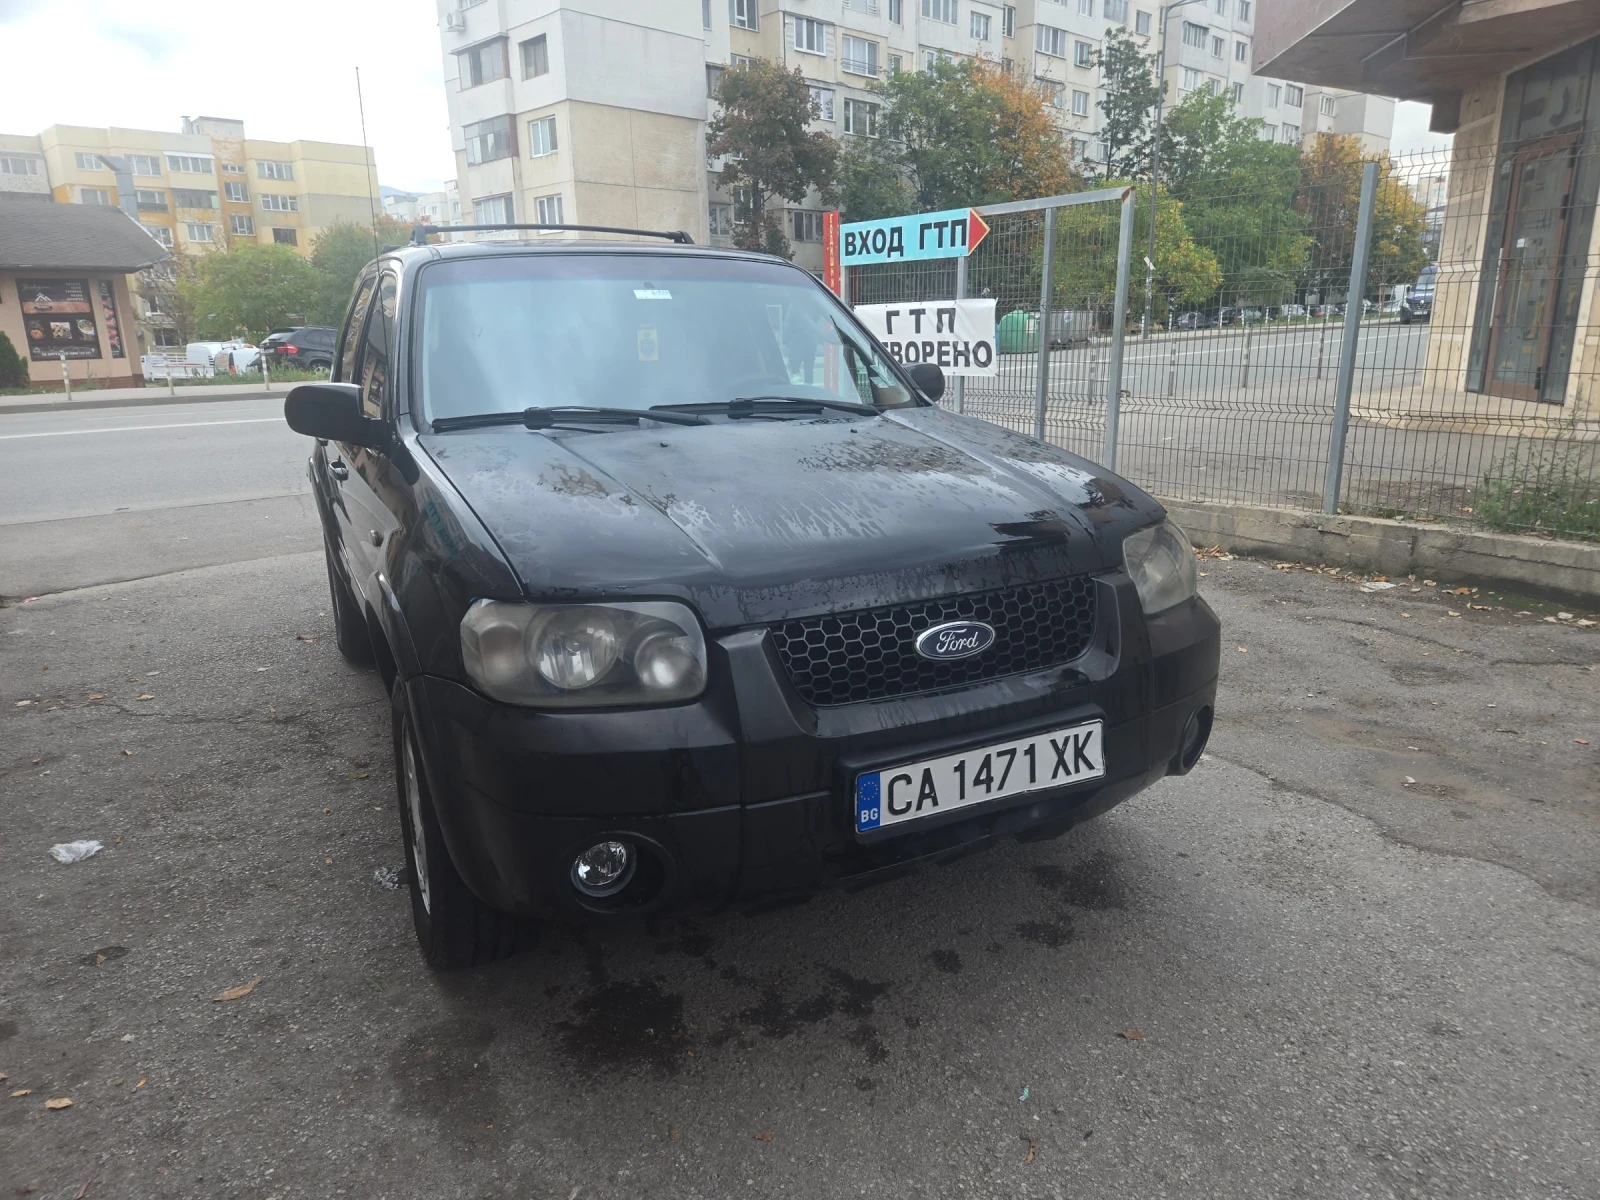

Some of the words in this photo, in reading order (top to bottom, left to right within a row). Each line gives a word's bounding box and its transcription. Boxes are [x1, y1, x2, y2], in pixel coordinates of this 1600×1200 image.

[844, 226, 904, 258] ВХОД
[919, 218, 967, 250] ГТП
[885, 307, 956, 335] ГТП
[881, 340, 993, 369] ВОРЕНО
[936, 628, 979, 653] Ford
[887, 767, 939, 816] CA
[953, 743, 1036, 800] 1471
[1049, 730, 1096, 779] XK
[860, 808, 879, 823] BG
